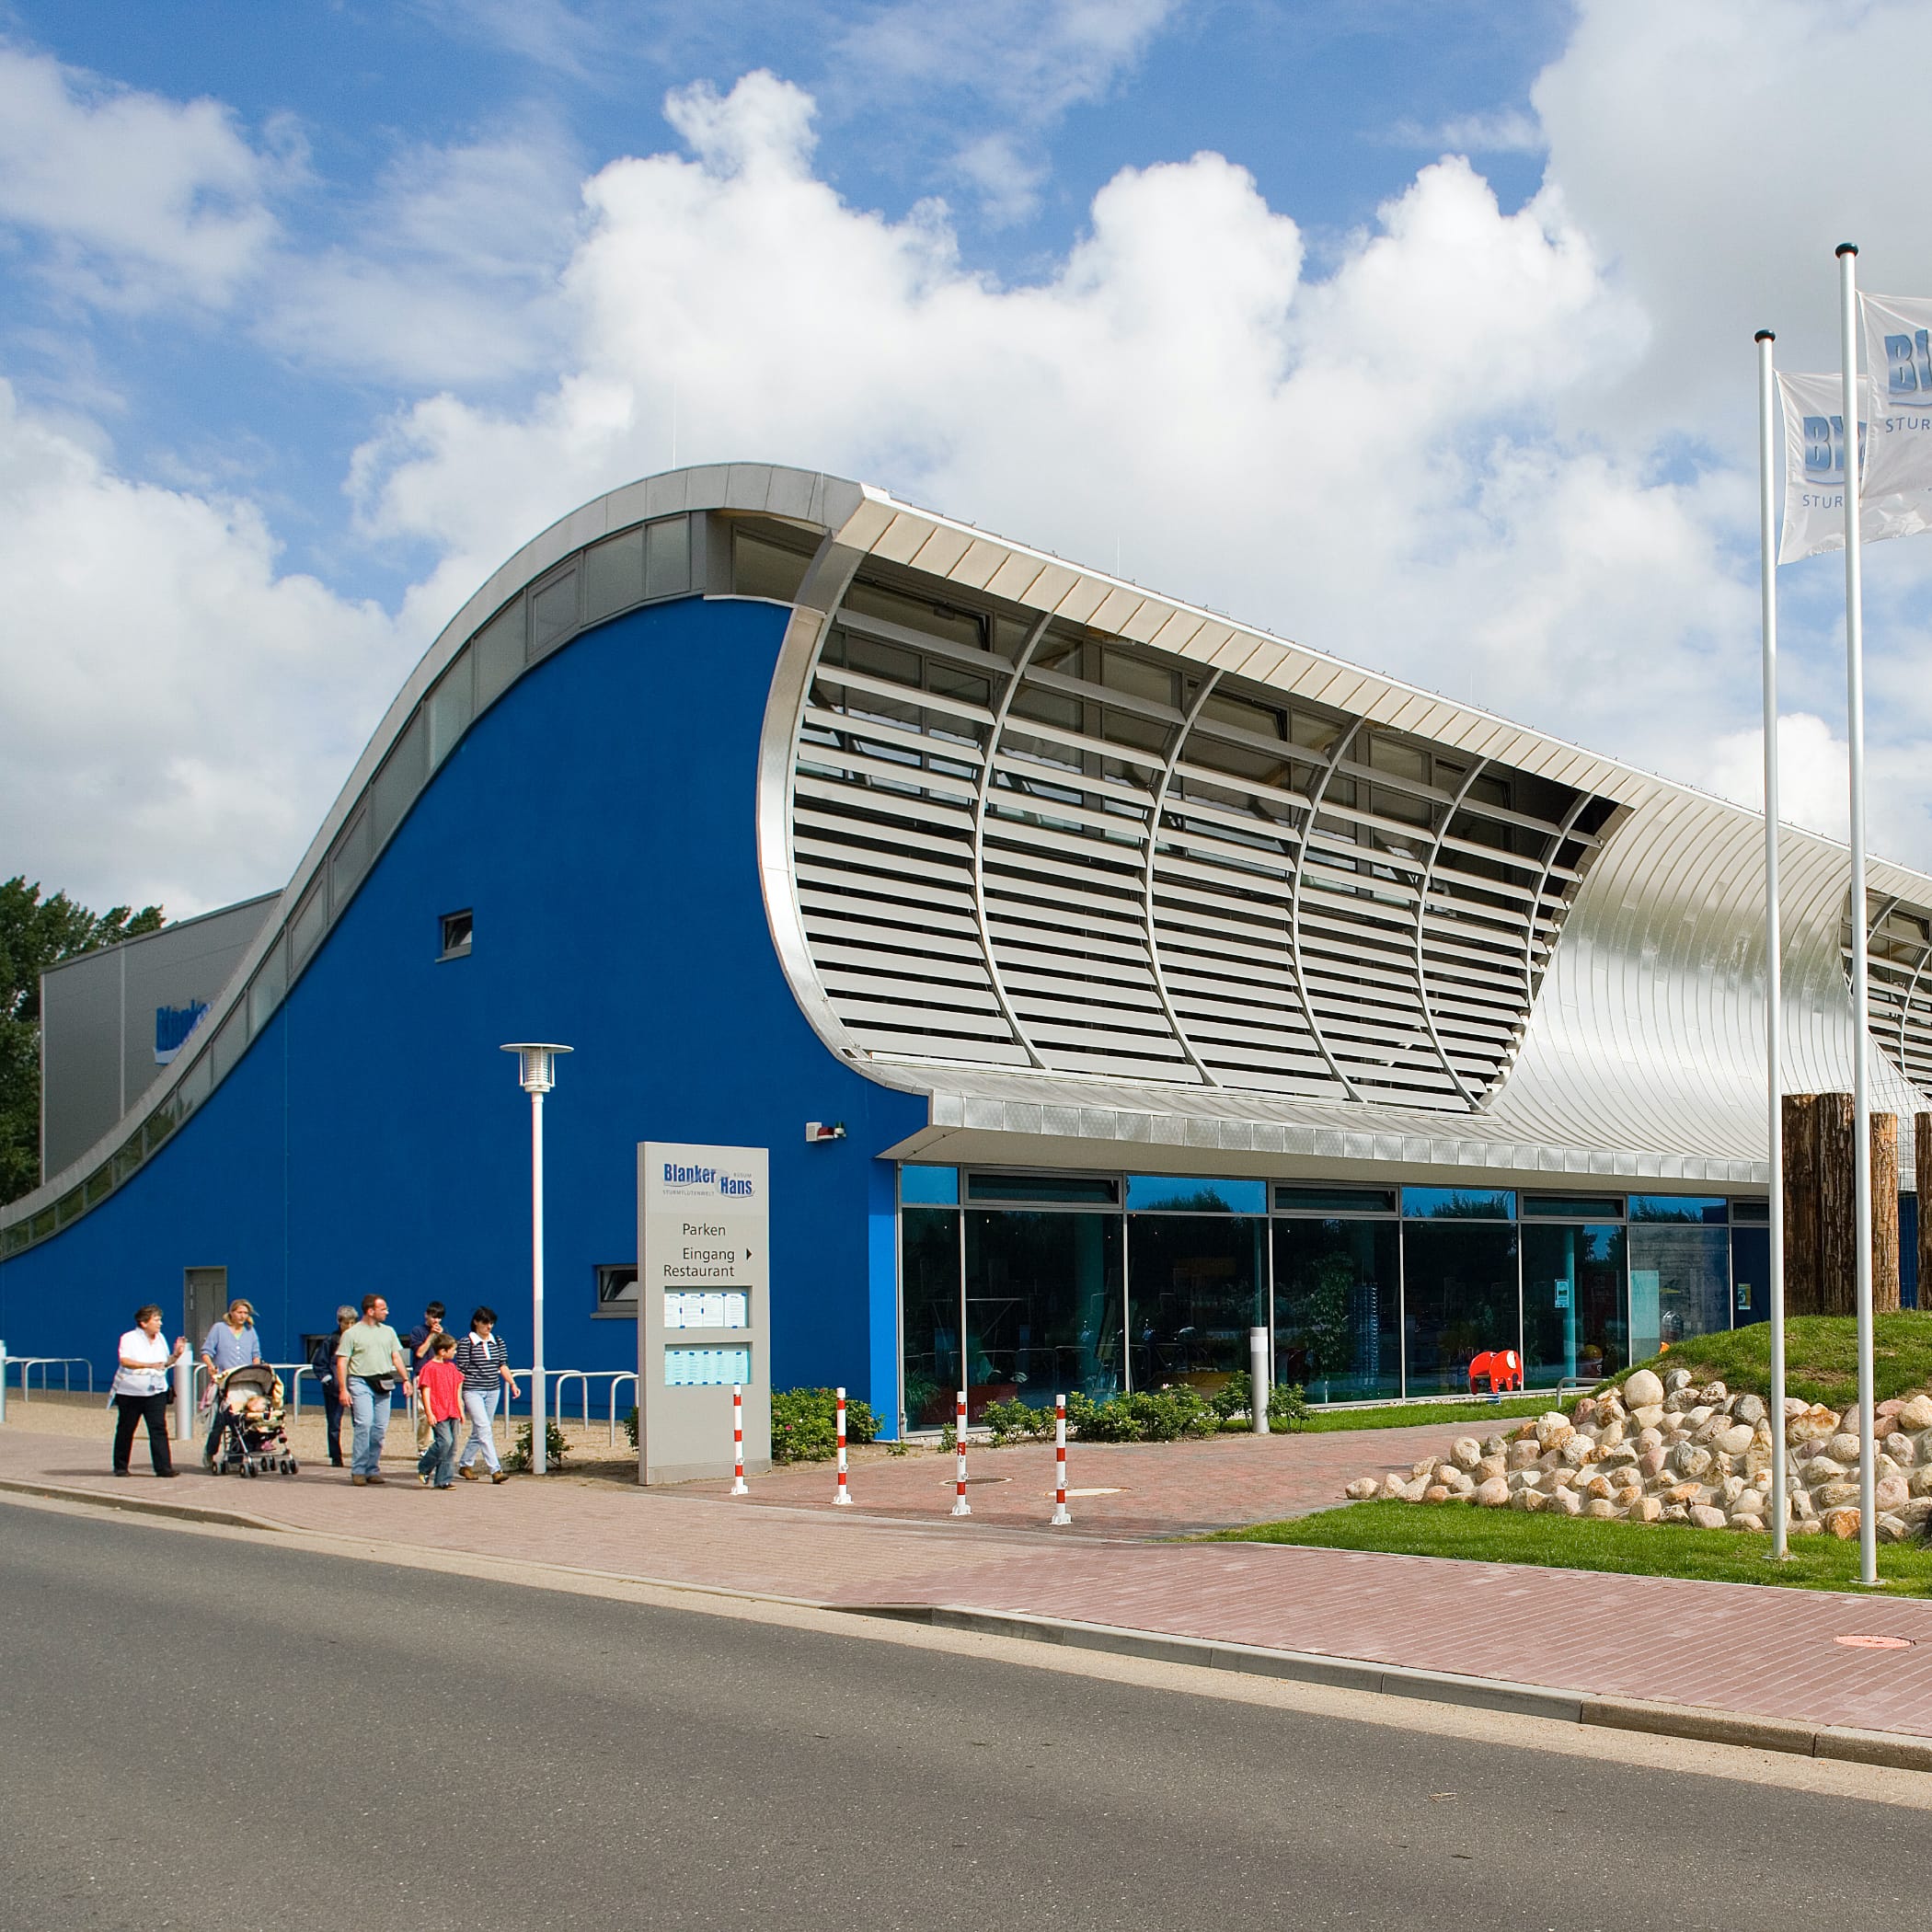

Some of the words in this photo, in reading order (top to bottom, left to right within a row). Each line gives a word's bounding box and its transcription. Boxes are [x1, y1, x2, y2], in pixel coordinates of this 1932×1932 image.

[1885, 417, 1930, 433] STUR
[1802, 494, 1843, 509] STUR
[664, 1163, 717, 1183] Blanker
[720, 1176, 753, 1195] Hans
[683, 1223, 726, 1236] Parken
[683, 1247, 735, 1263] Eingang
[663, 1264, 735, 1277] Restaurant
